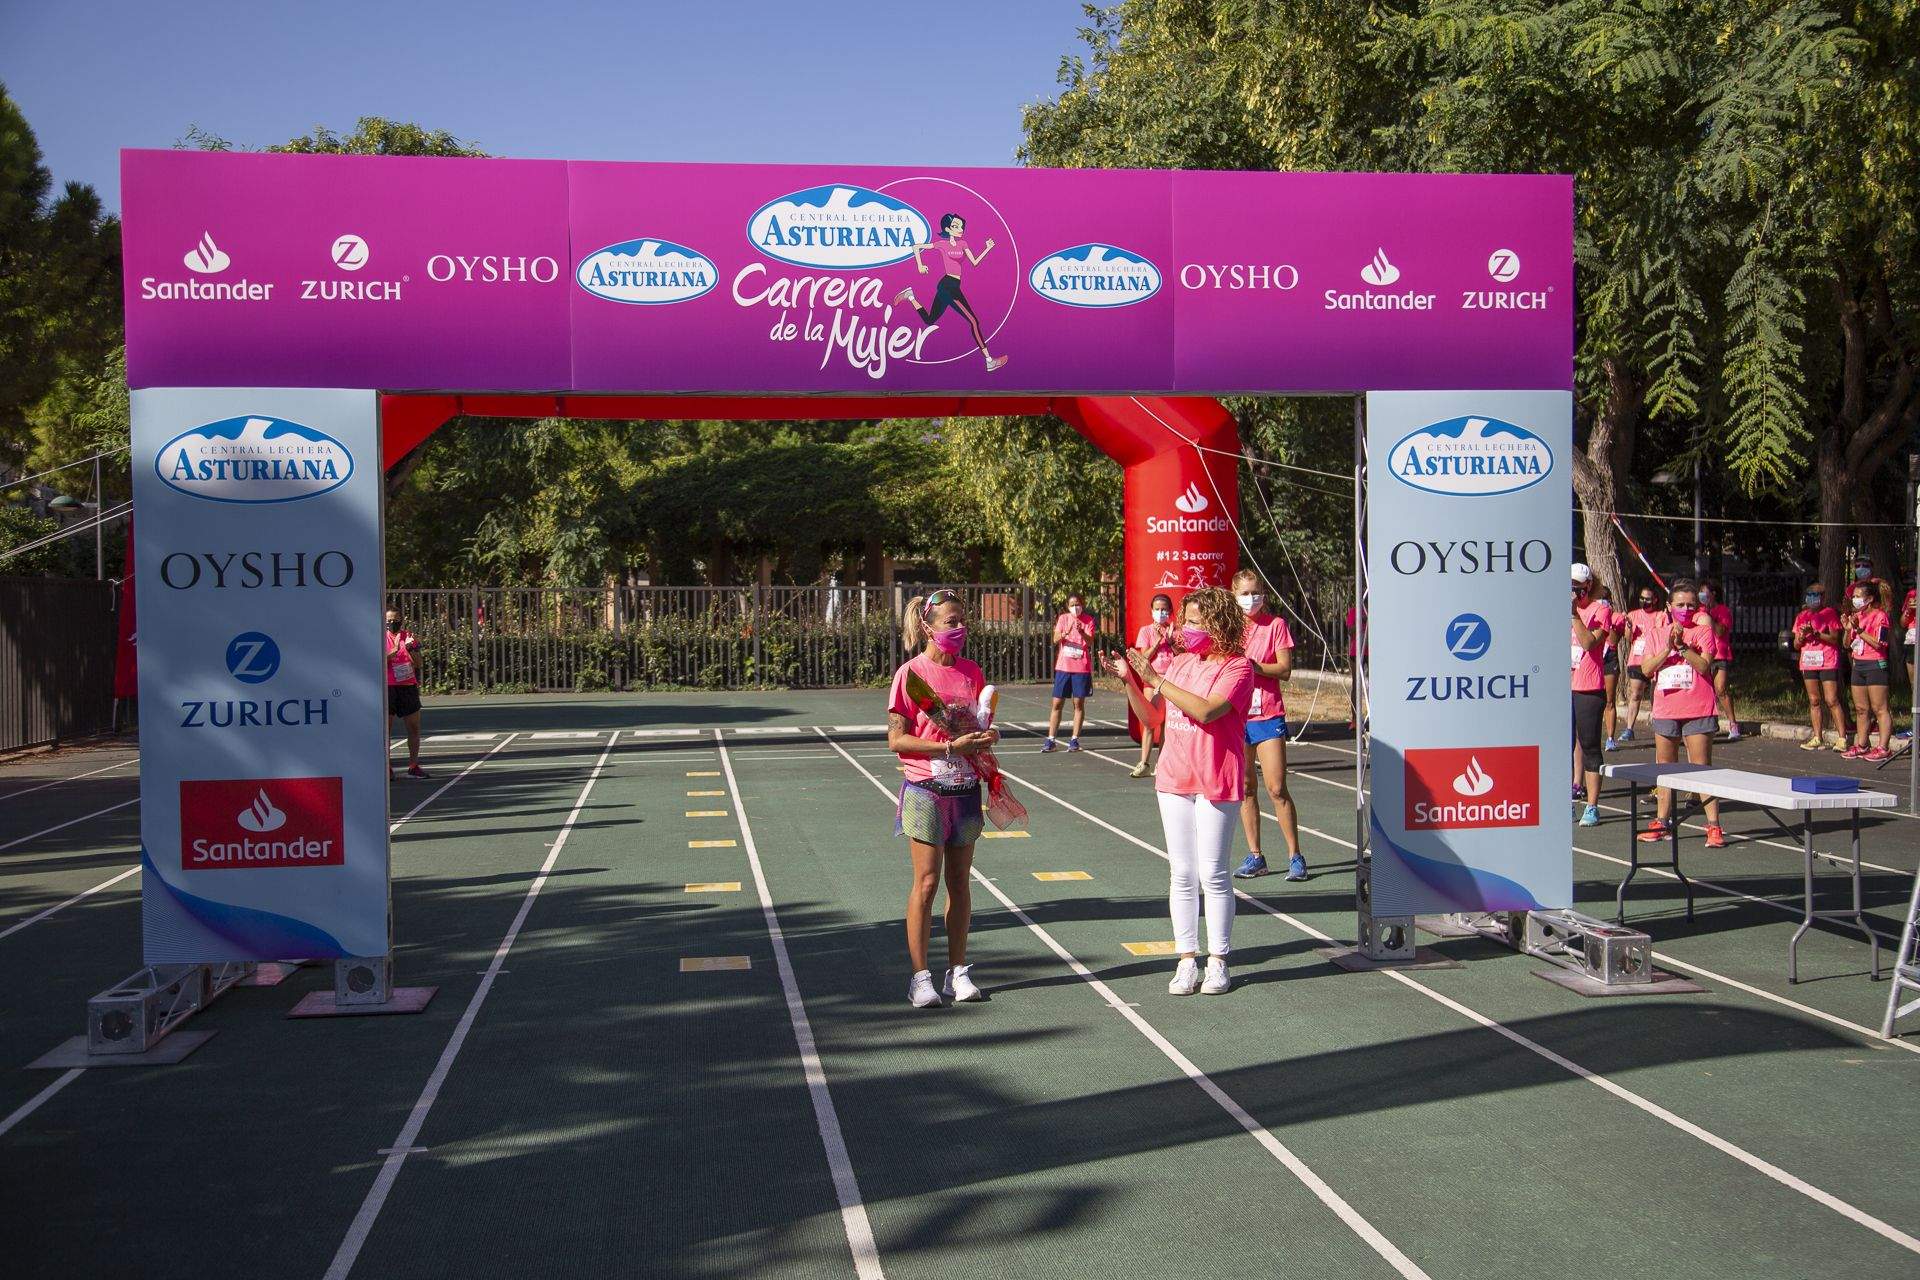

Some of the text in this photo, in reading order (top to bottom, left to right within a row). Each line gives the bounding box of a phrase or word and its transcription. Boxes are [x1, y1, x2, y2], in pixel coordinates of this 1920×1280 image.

[762, 214, 918, 248] ASTURIANA
[790, 213, 911, 222] CENTRAL LECHERA
[426, 255, 560, 283] OYSHO
[588, 262, 708, 287] ASTURIANA
[1040, 266, 1152, 291] ASTURIANA
[1180, 263, 1300, 291] OYSHO
[141, 277, 274, 301] Santander
[732, 262, 884, 309] Carrera
[1324, 289, 1436, 311] Santander
[769, 305, 940, 379] de la Mujer
[200, 446, 333, 454] CENTRAL LECHERA
[1401, 446, 1542, 475] ASTURIANA
[1427, 443, 1537, 451] CENTRAL LECHERA
[170, 448, 340, 481] ASTURIANA
[1146, 516, 1230, 533] Santander
[160, 550, 355, 590] OYSHO
[1390, 539, 1552, 575] OYSHO
[1414, 800, 1530, 825] Santander
[192, 836, 333, 863] Santander
